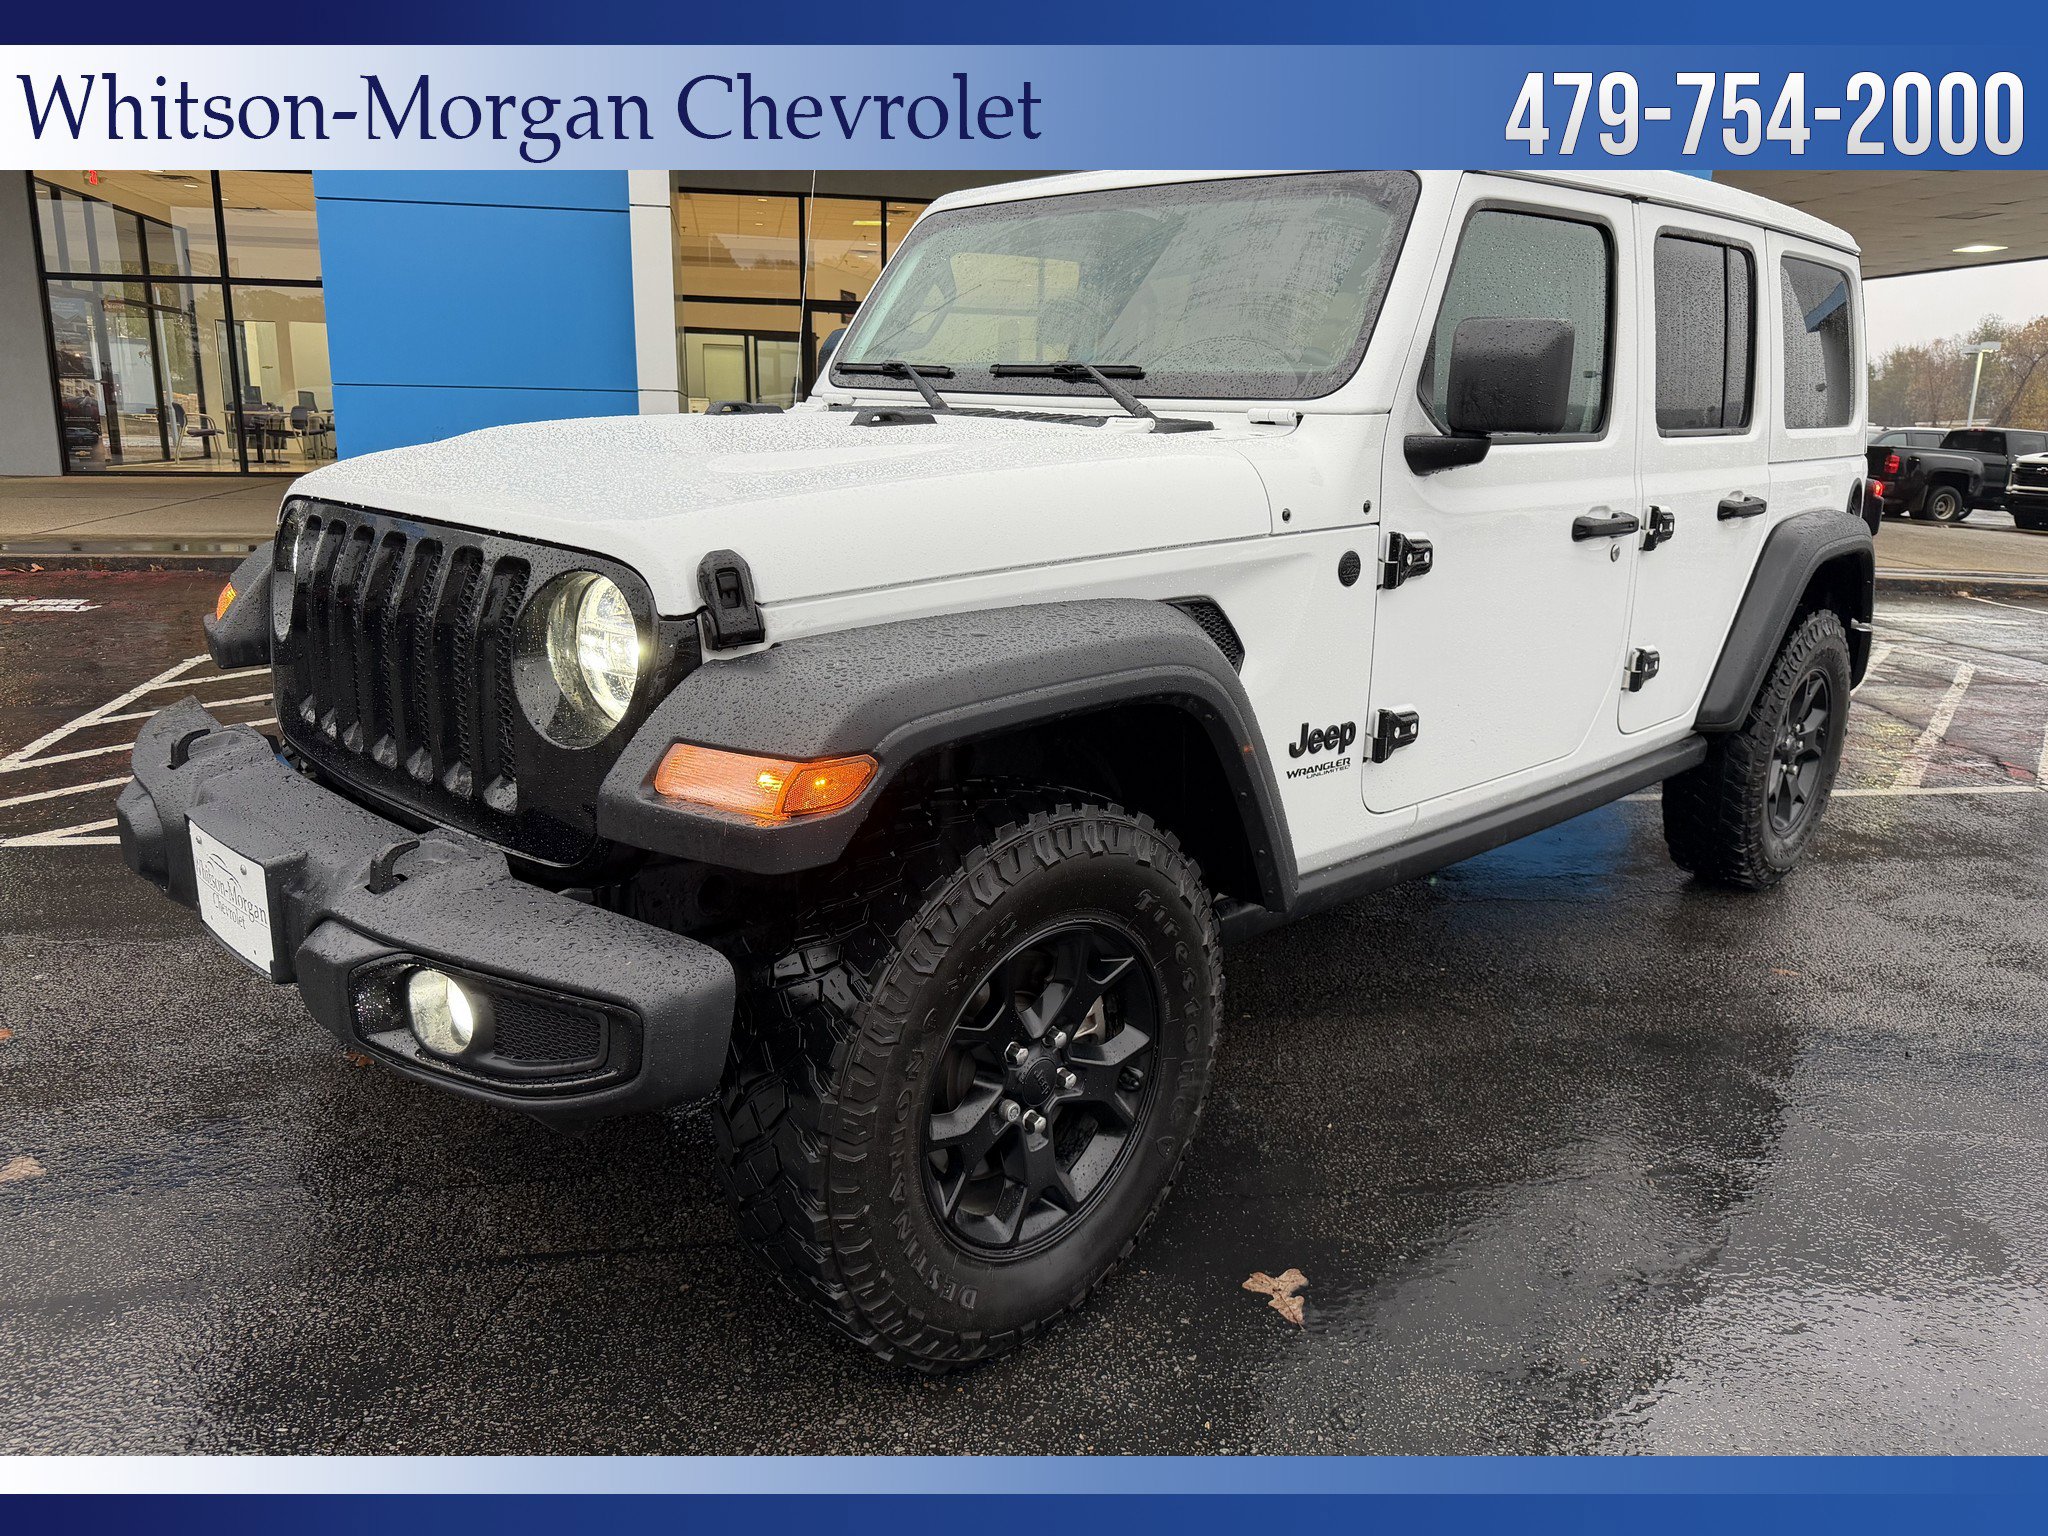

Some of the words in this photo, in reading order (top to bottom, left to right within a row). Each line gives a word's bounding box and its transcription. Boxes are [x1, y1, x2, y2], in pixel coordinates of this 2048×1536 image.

[1289, 721, 1357, 758] Jeep
[1286, 757, 1351, 779] WRANGLER
[1306, 765, 1351, 780] UNLIMITED
[195, 857, 269, 924] Whitson-Morgan
[212, 892, 247, 930] Chevrolet
[1033, 1069, 1052, 1096] Jeep
[888, 1047, 980, 1311] DESTINATION
